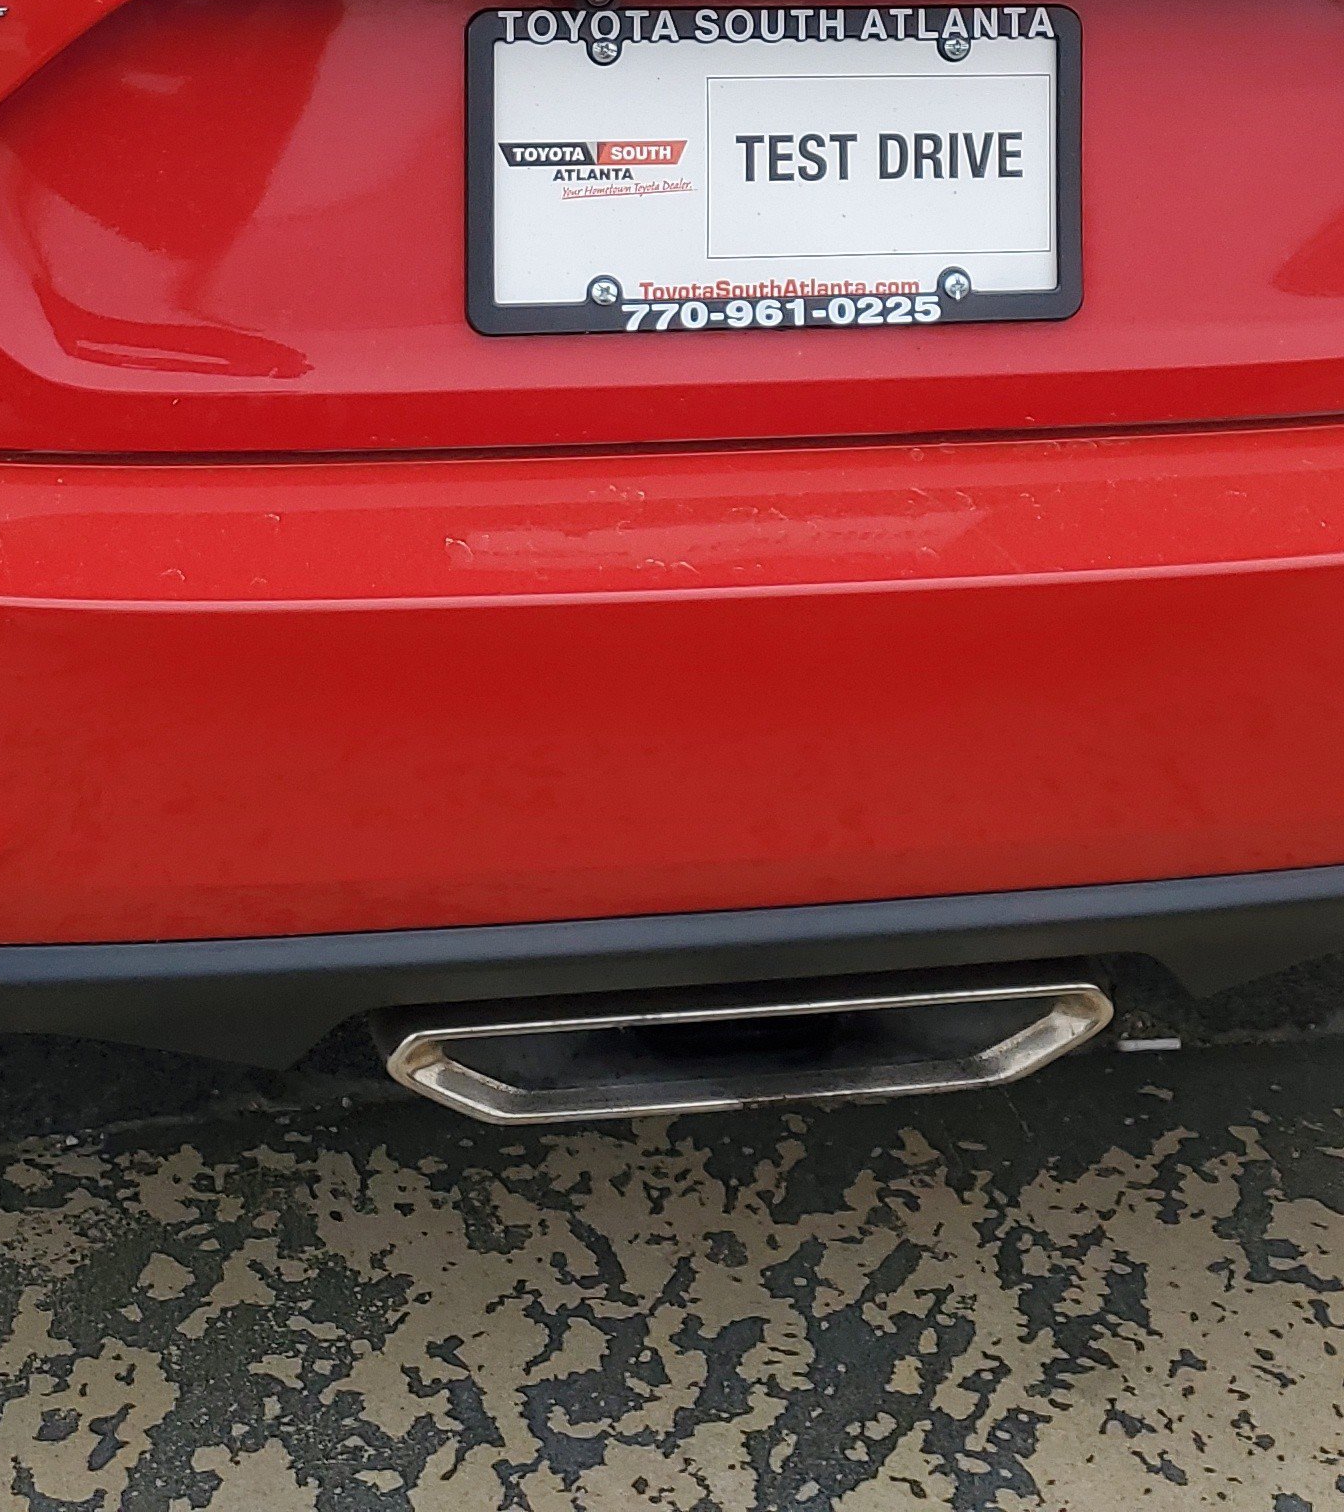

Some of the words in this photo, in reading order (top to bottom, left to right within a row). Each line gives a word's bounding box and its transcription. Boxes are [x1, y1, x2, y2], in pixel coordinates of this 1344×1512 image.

[498, 9, 680, 44] TOYOTA
[693, 8, 846, 43] SOUTH
[859, 6, 1056, 40] ATLANTA
[512, 147, 585, 162] TOYOTA
[610, 145, 672, 161] SOUTH
[735, 133, 858, 182] TEST
[878, 131, 1024, 180] DRIVE
[552, 168, 634, 182] ATLANTA
[562, 186, 582, 198] Your
[584, 183, 632, 196] Hometown
[634, 182, 661, 198] Toyota
[639, 279, 920, 300] ToyotaSouthAtlanta.com
[621, 296, 942, 331] 770-961-0225
